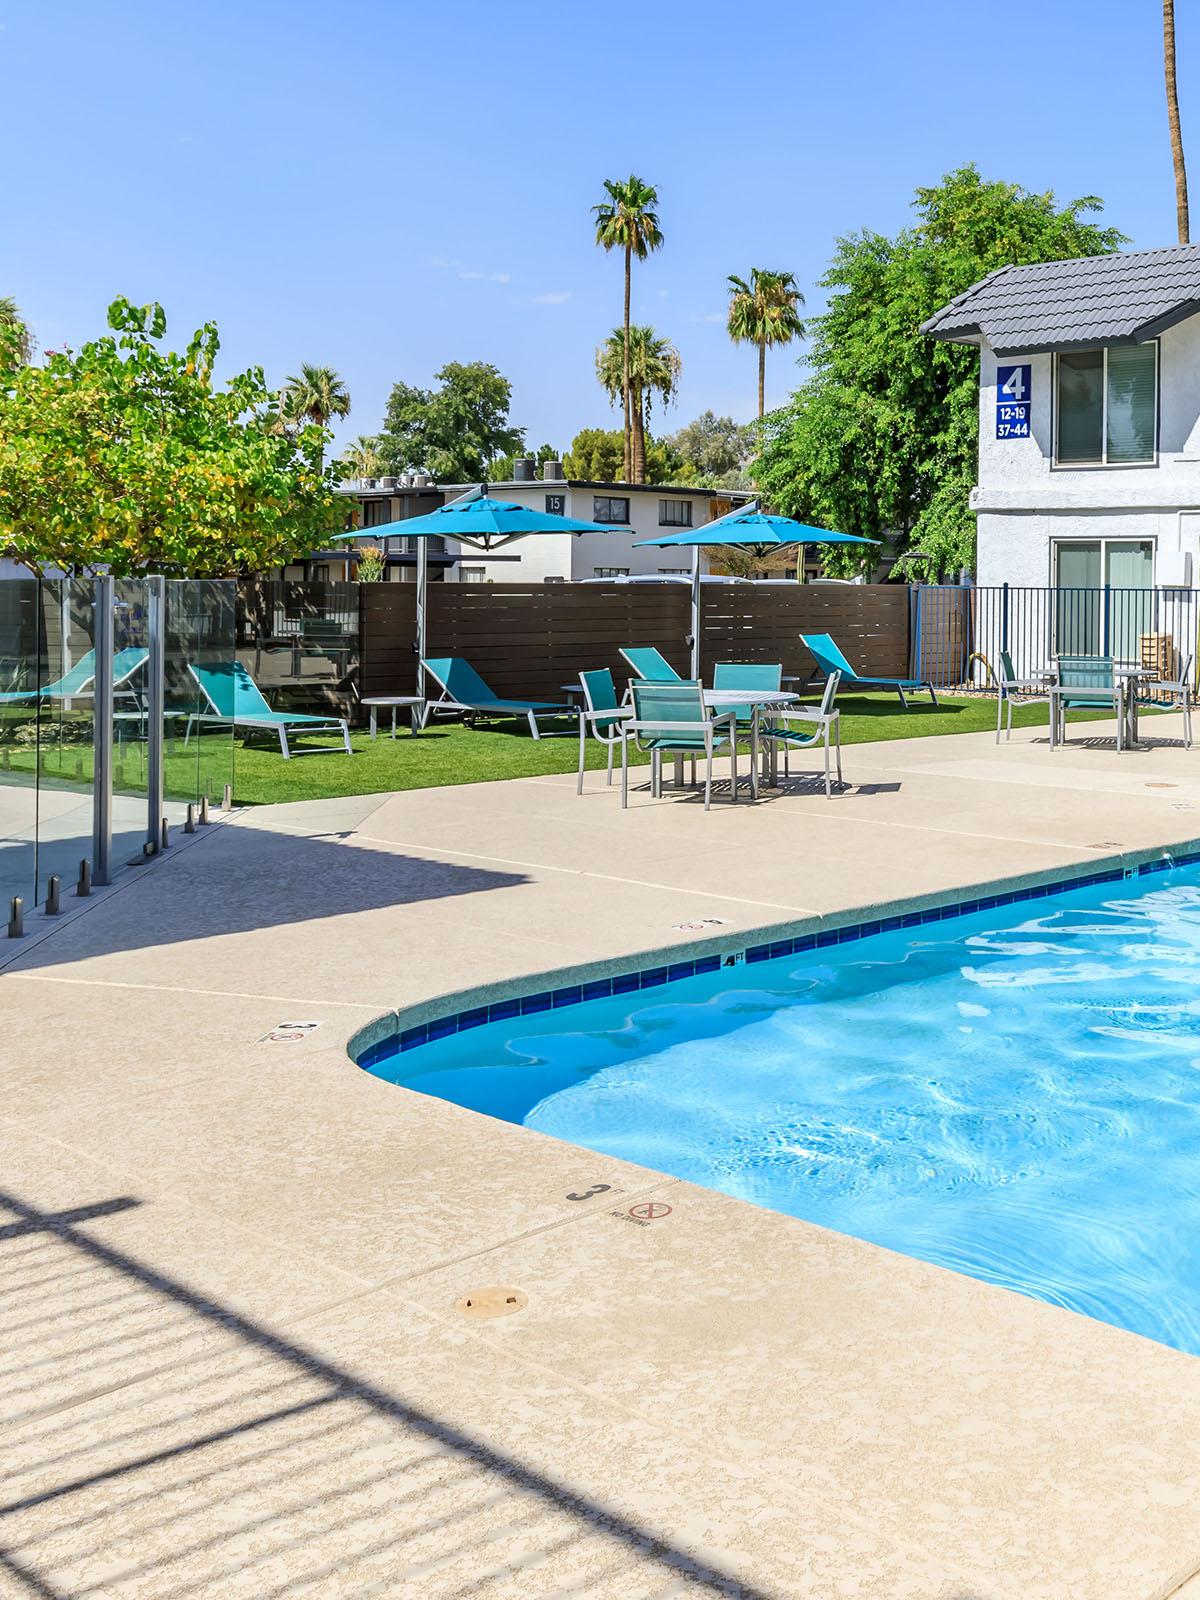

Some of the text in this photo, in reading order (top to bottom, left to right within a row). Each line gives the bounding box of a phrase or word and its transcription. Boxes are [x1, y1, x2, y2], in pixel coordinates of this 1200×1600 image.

[1002, 367, 1026, 399] 4
[1000, 406, 1026, 420] 12-19
[998, 423, 1028, 437] 37-44
[550, 497, 560, 510] 15
[566, 1184, 612, 1201] 3
